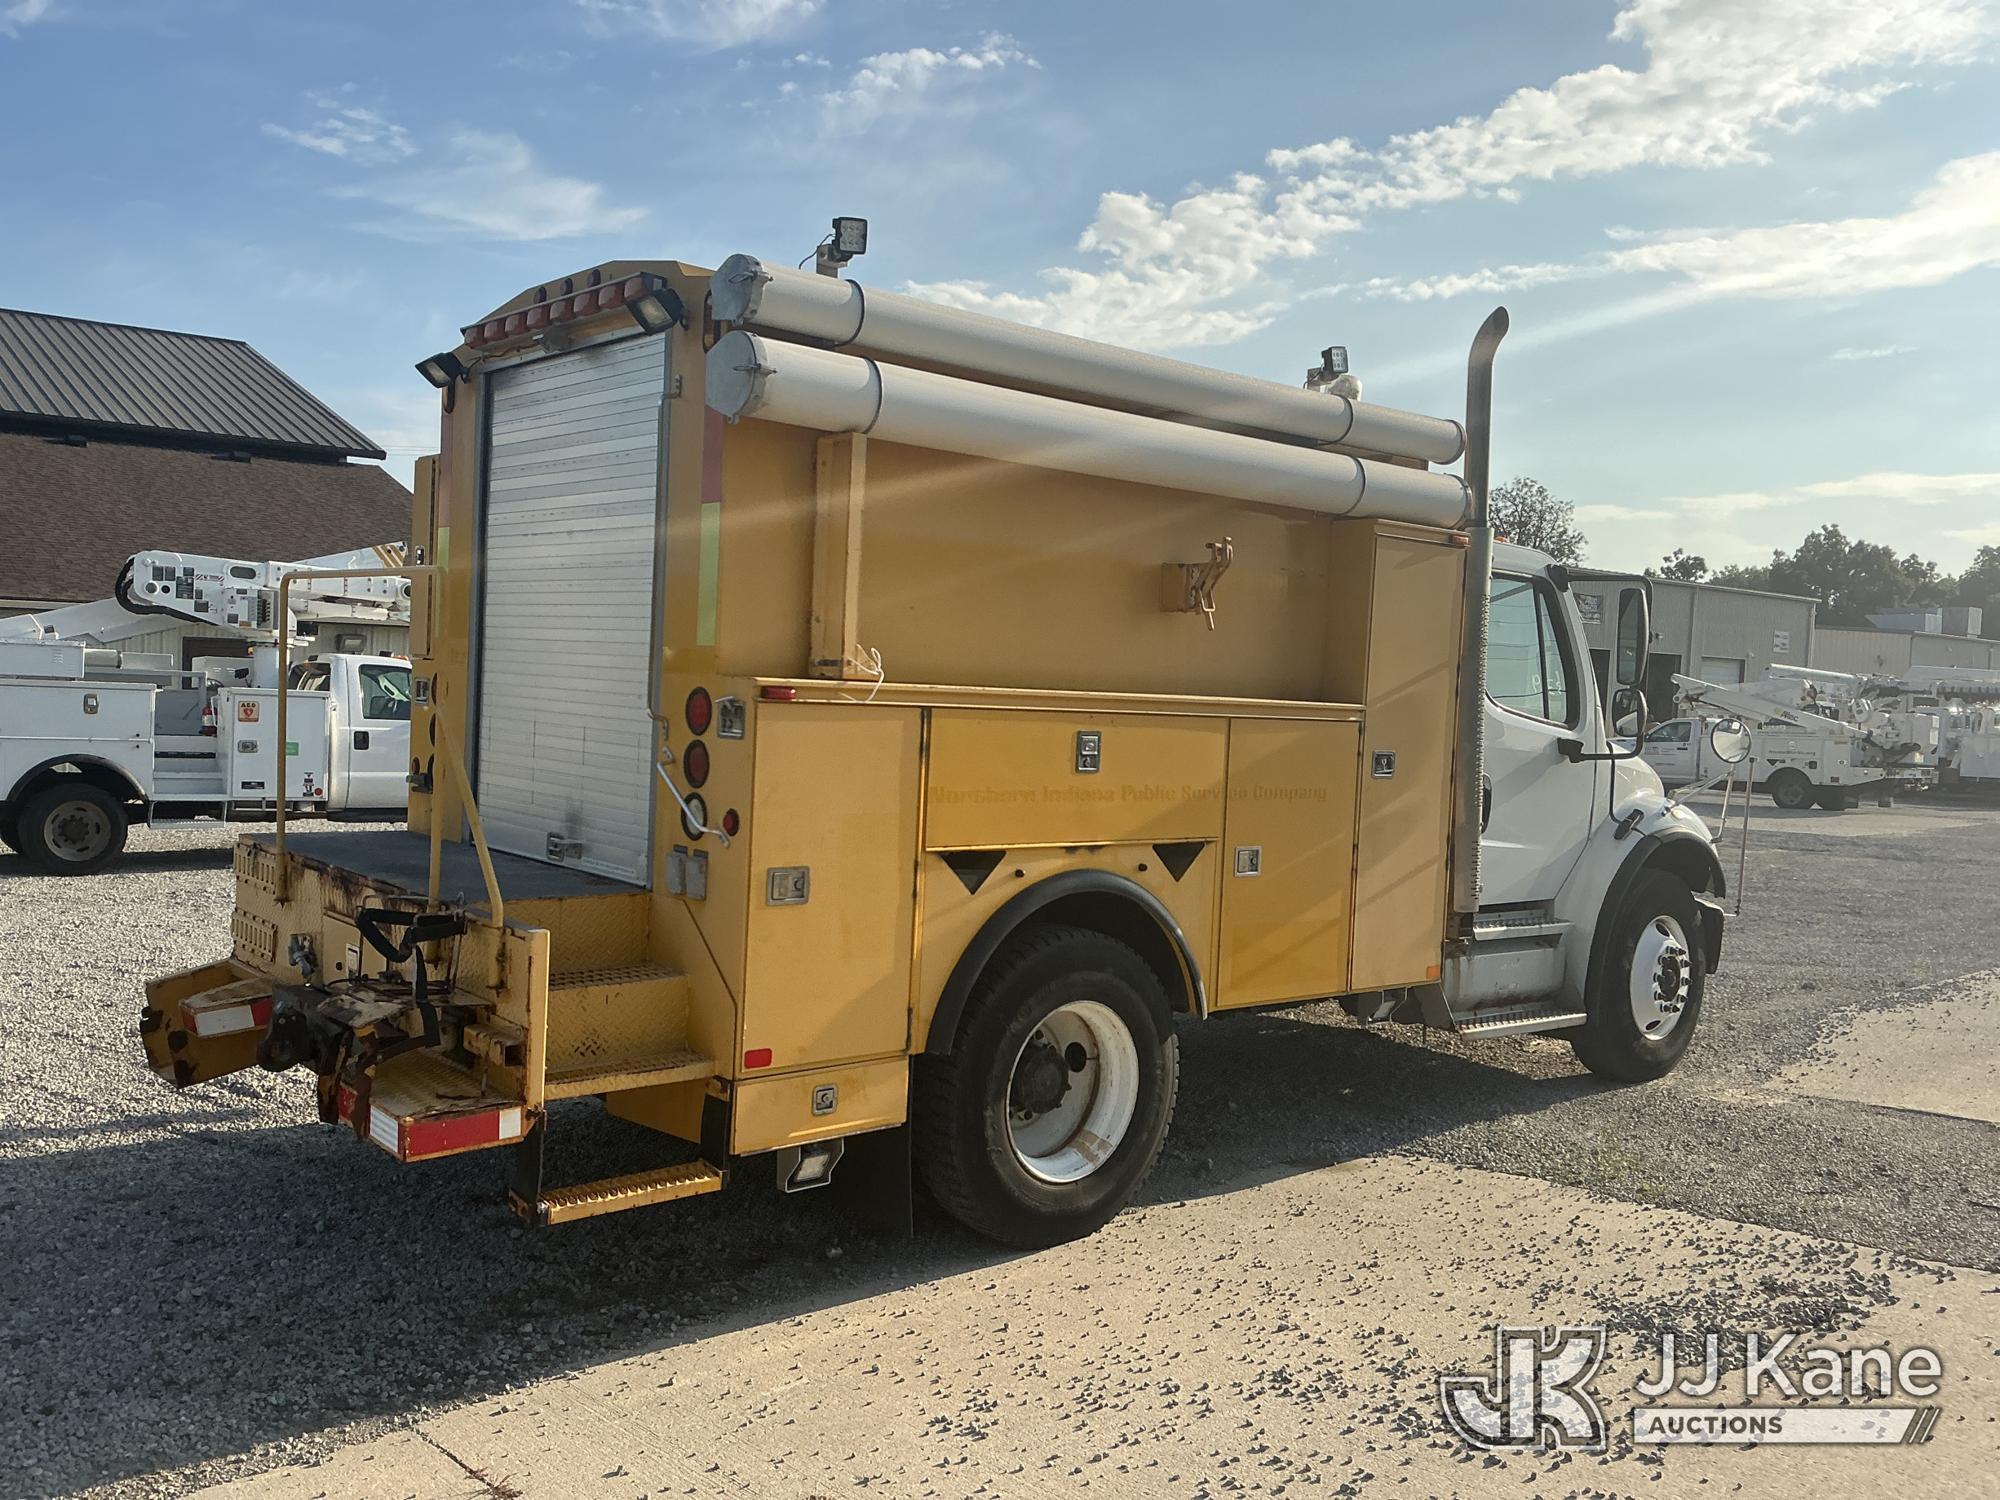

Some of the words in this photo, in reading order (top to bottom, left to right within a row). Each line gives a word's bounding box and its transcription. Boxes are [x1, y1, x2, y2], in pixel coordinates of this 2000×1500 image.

[929, 785, 1037, 804] Northern
[1043, 784, 1117, 803] Indiana
[1121, 783, 1177, 802] Public
[1253, 783, 1328, 804] Company
